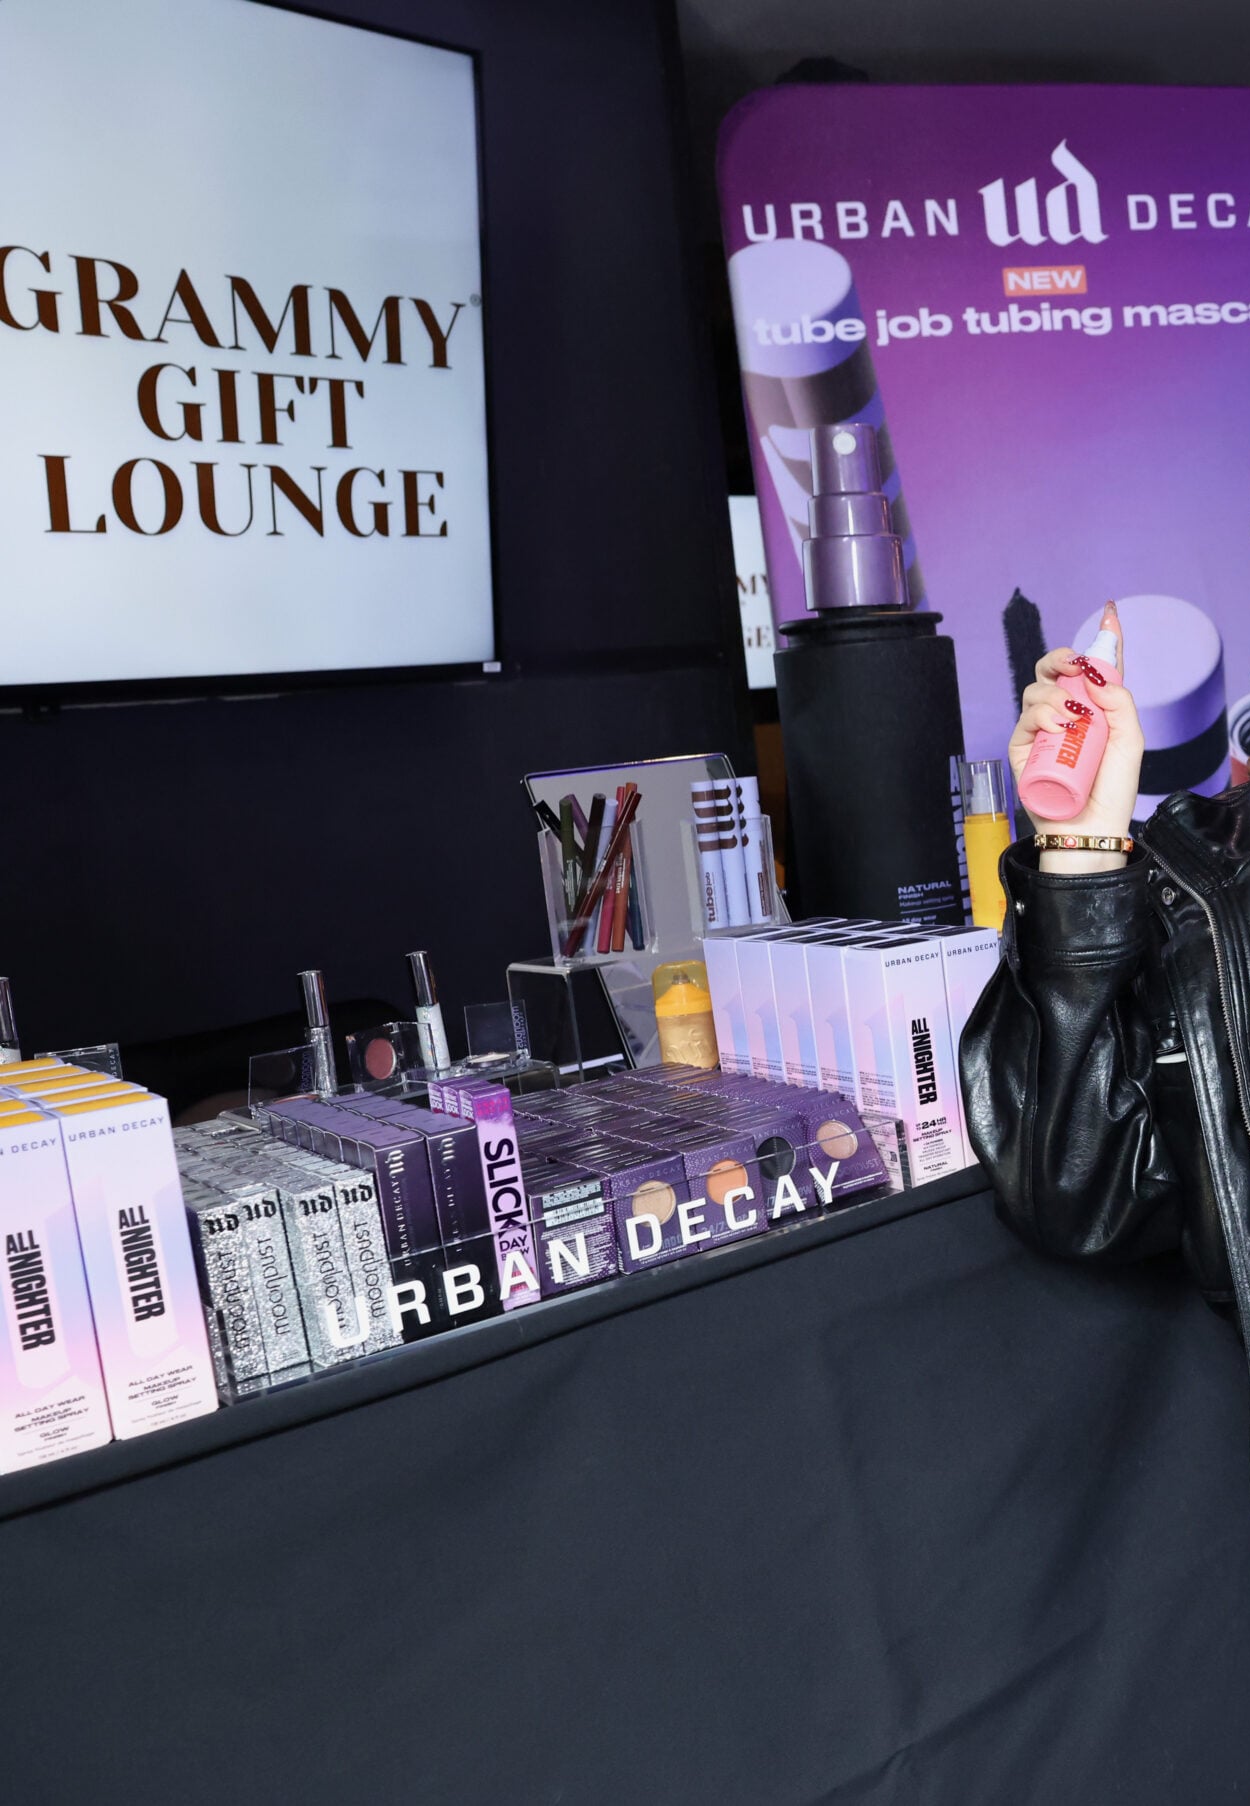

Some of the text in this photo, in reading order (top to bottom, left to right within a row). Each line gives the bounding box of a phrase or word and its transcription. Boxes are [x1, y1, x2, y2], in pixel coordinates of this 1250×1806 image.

[741, 198, 959, 243] URBAN
[1006, 268, 1083, 292] NEW
[0, 245, 466, 369] GRAMMY
[753, 314, 868, 346] tube
[875, 307, 953, 346] job
[962, 300, 1113, 337] tubing
[137, 362, 365, 449] GIFT
[37, 453, 448, 538] LOUNGE
[897, 880, 952, 895] NATURAL
[885, 951, 940, 968] URBAN DECAY
[946, 941, 998, 958] URBAN DECAY
[911, 1017, 931, 1035] ALL
[912, 1033, 938, 1106] NIGHTER
[68, 1116, 166, 1143] URBAN DECAY
[10, 1138, 58, 1155] DECAY
[483, 1137, 529, 1240] SLICK
[118, 1204, 149, 1230] ALL
[6, 1229, 40, 1255] ALL
[325, 1231, 592, 1350] URBAN
[625, 1160, 841, 1261] DECAY
[499, 1235, 528, 1252] DAY
[501, 1246, 530, 1262] BW
[120, 1225, 165, 1322] NIGHTER
[7, 1250, 56, 1351] NIGHTER
[127, 1364, 193, 1388] ALL DAY WEAR
[128, 1376, 197, 1401] SETTING SPRAY
[143, 1376, 181, 1391] MAKEUP
[14, 1407, 89, 1433] SETTING SPRAY
[15, 1395, 85, 1419] ALL DAY WEAR
[31, 1407, 71, 1422] MAKEUP
